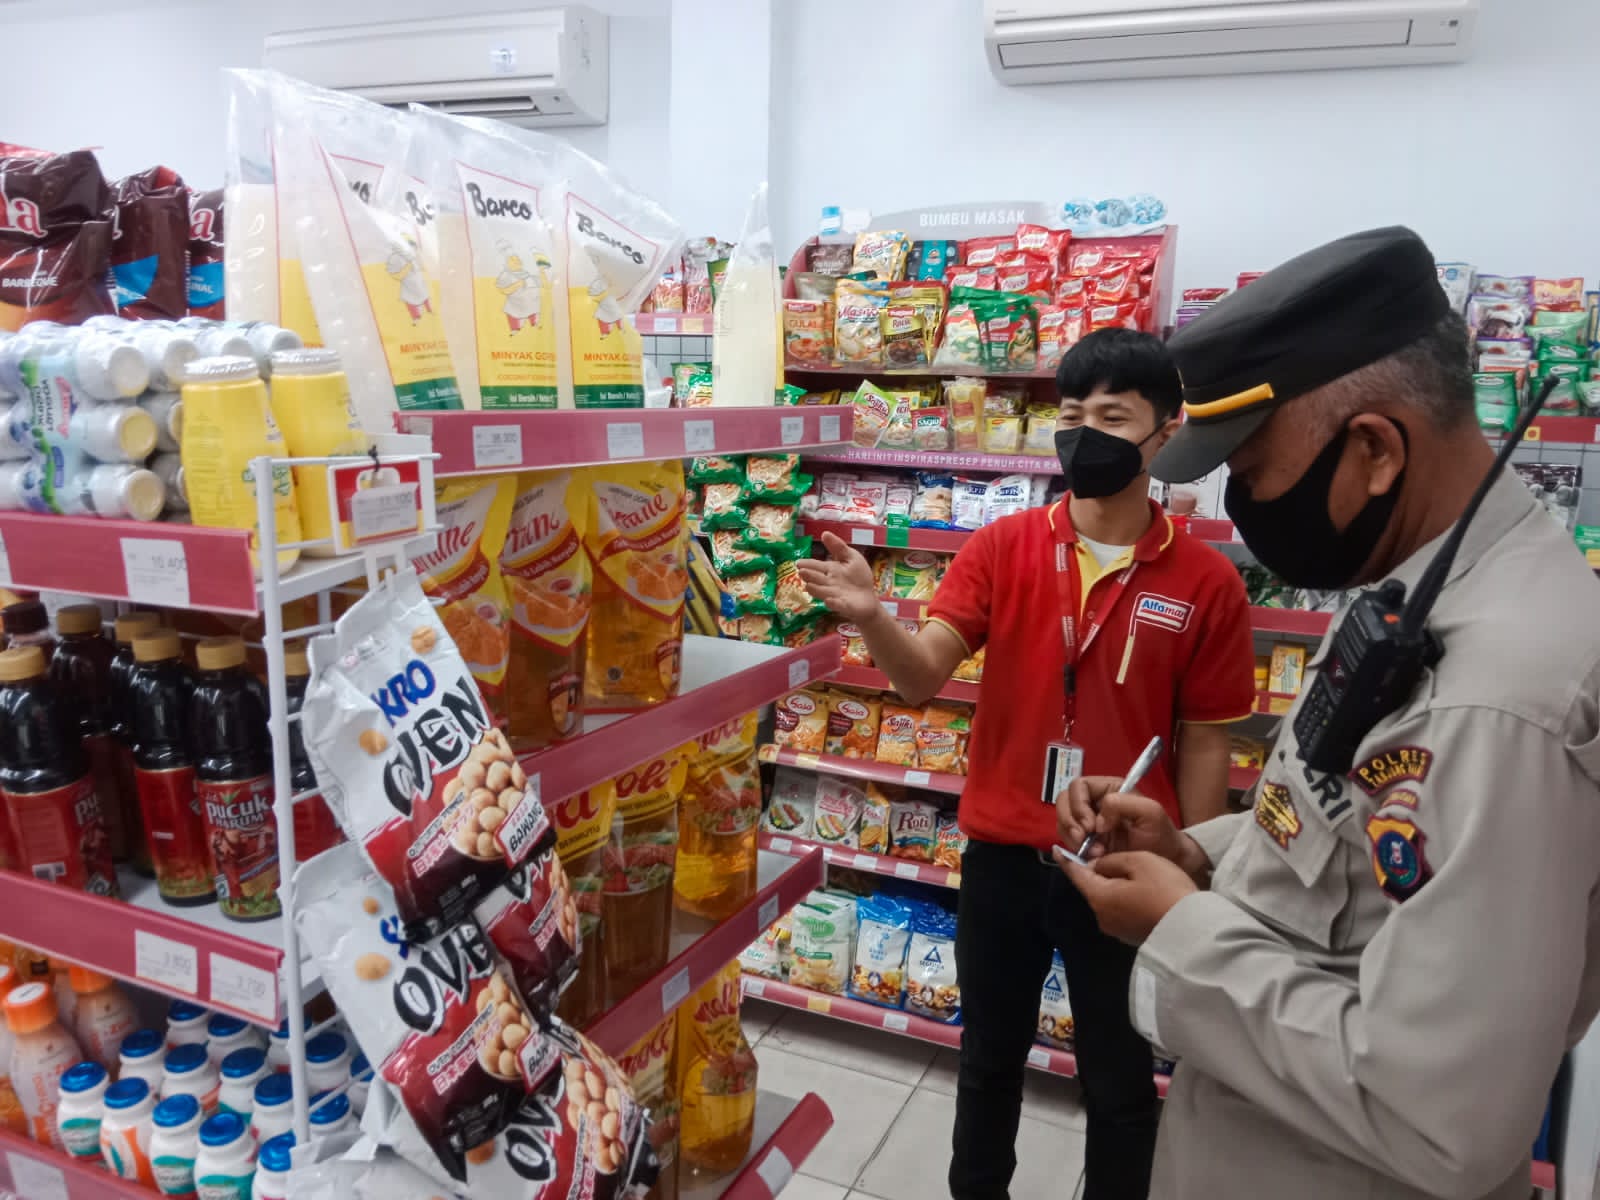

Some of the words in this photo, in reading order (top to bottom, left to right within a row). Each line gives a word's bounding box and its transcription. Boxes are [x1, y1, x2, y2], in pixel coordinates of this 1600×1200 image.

[465, 181, 532, 221] Barco
[919, 213, 971, 229] BUMBU
[974, 209, 1026, 226] MASAK
[574, 211, 645, 266] Barco
[491, 350, 533, 362] MINYAK
[583, 351, 620, 363] MINYAK
[981, 457, 1016, 468] PENUH
[1017, 459, 1042, 469] CITA
[370, 658, 437, 729] KRO
[789, 699, 815, 714] Sasa
[842, 704, 867, 719] Sasa
[383, 675, 492, 821] OVEN
[1358, 749, 1428, 782] POLRES
[509, 800, 543, 853] BAWANG
[895, 811, 929, 832] Roti
